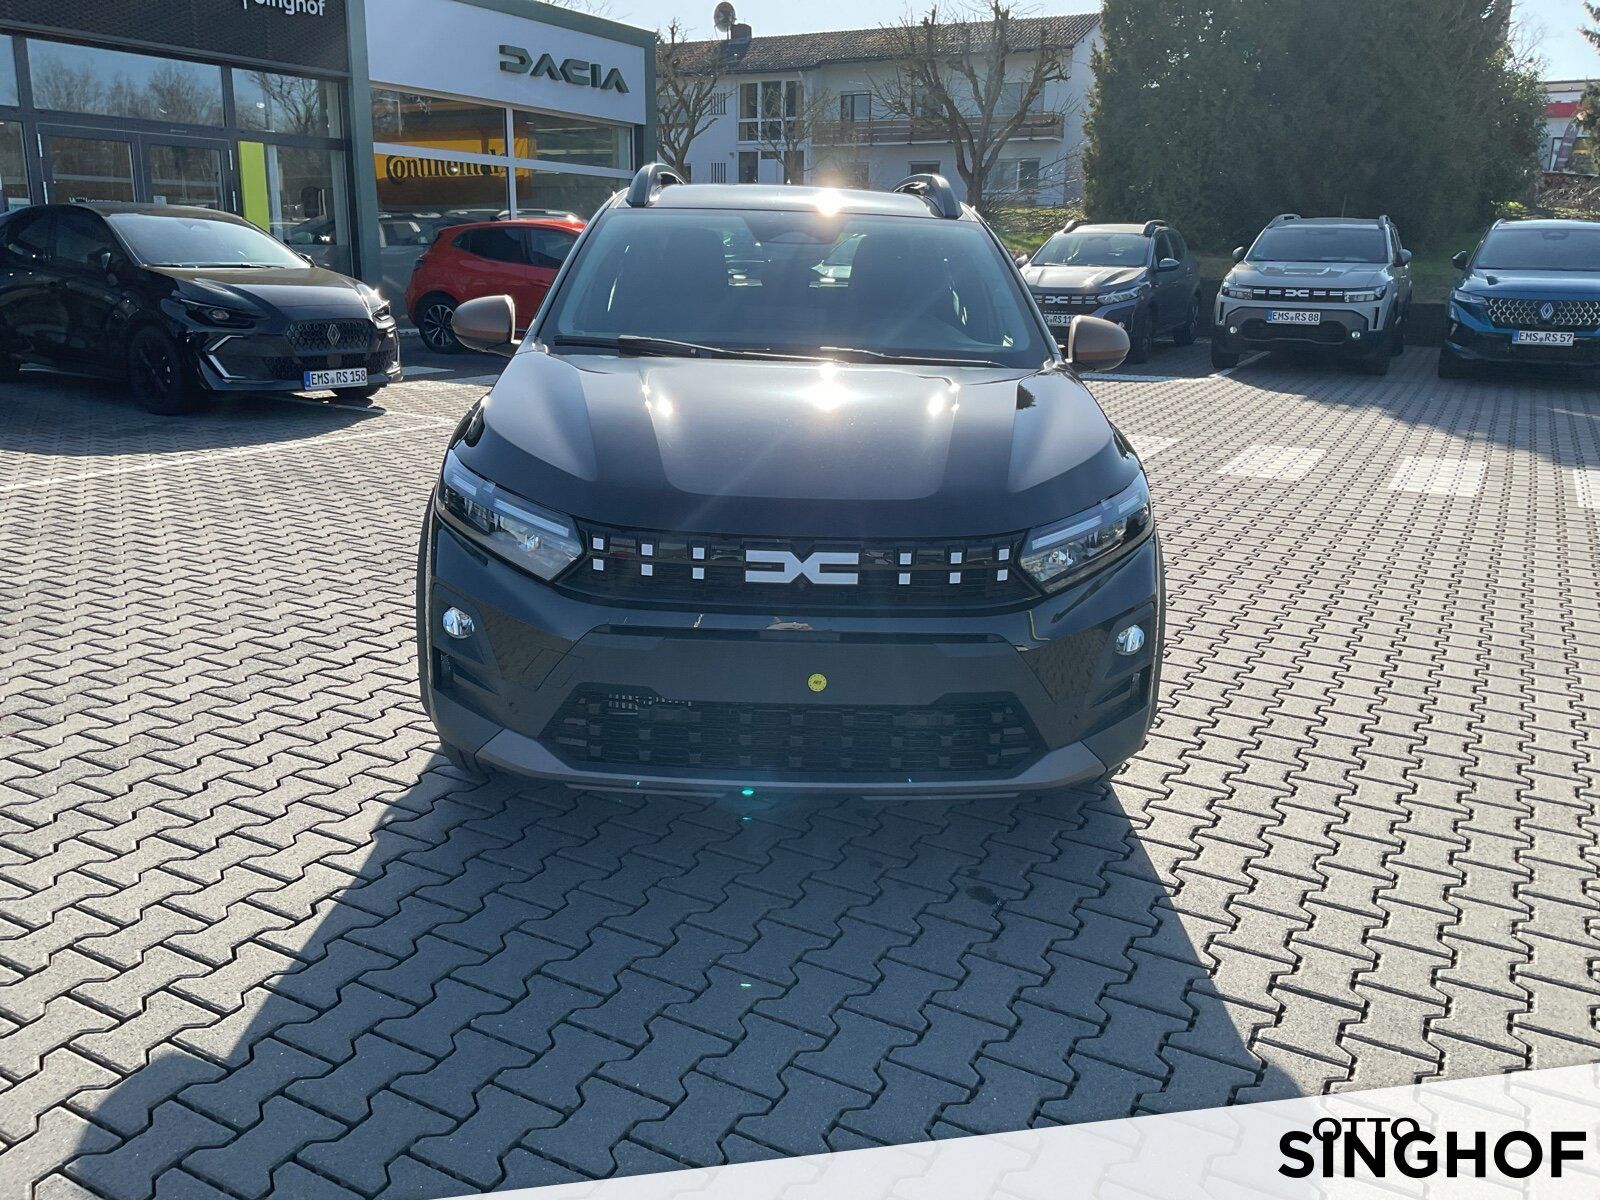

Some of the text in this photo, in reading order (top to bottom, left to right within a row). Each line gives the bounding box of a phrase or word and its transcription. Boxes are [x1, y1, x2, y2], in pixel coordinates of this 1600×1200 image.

[498, 44, 630, 93] DACIA
[1272, 312, 1319, 322] EMS RS 88
[1518, 332, 1573, 343] EMS RS 57
[311, 370, 366, 386] EMS RS 158
